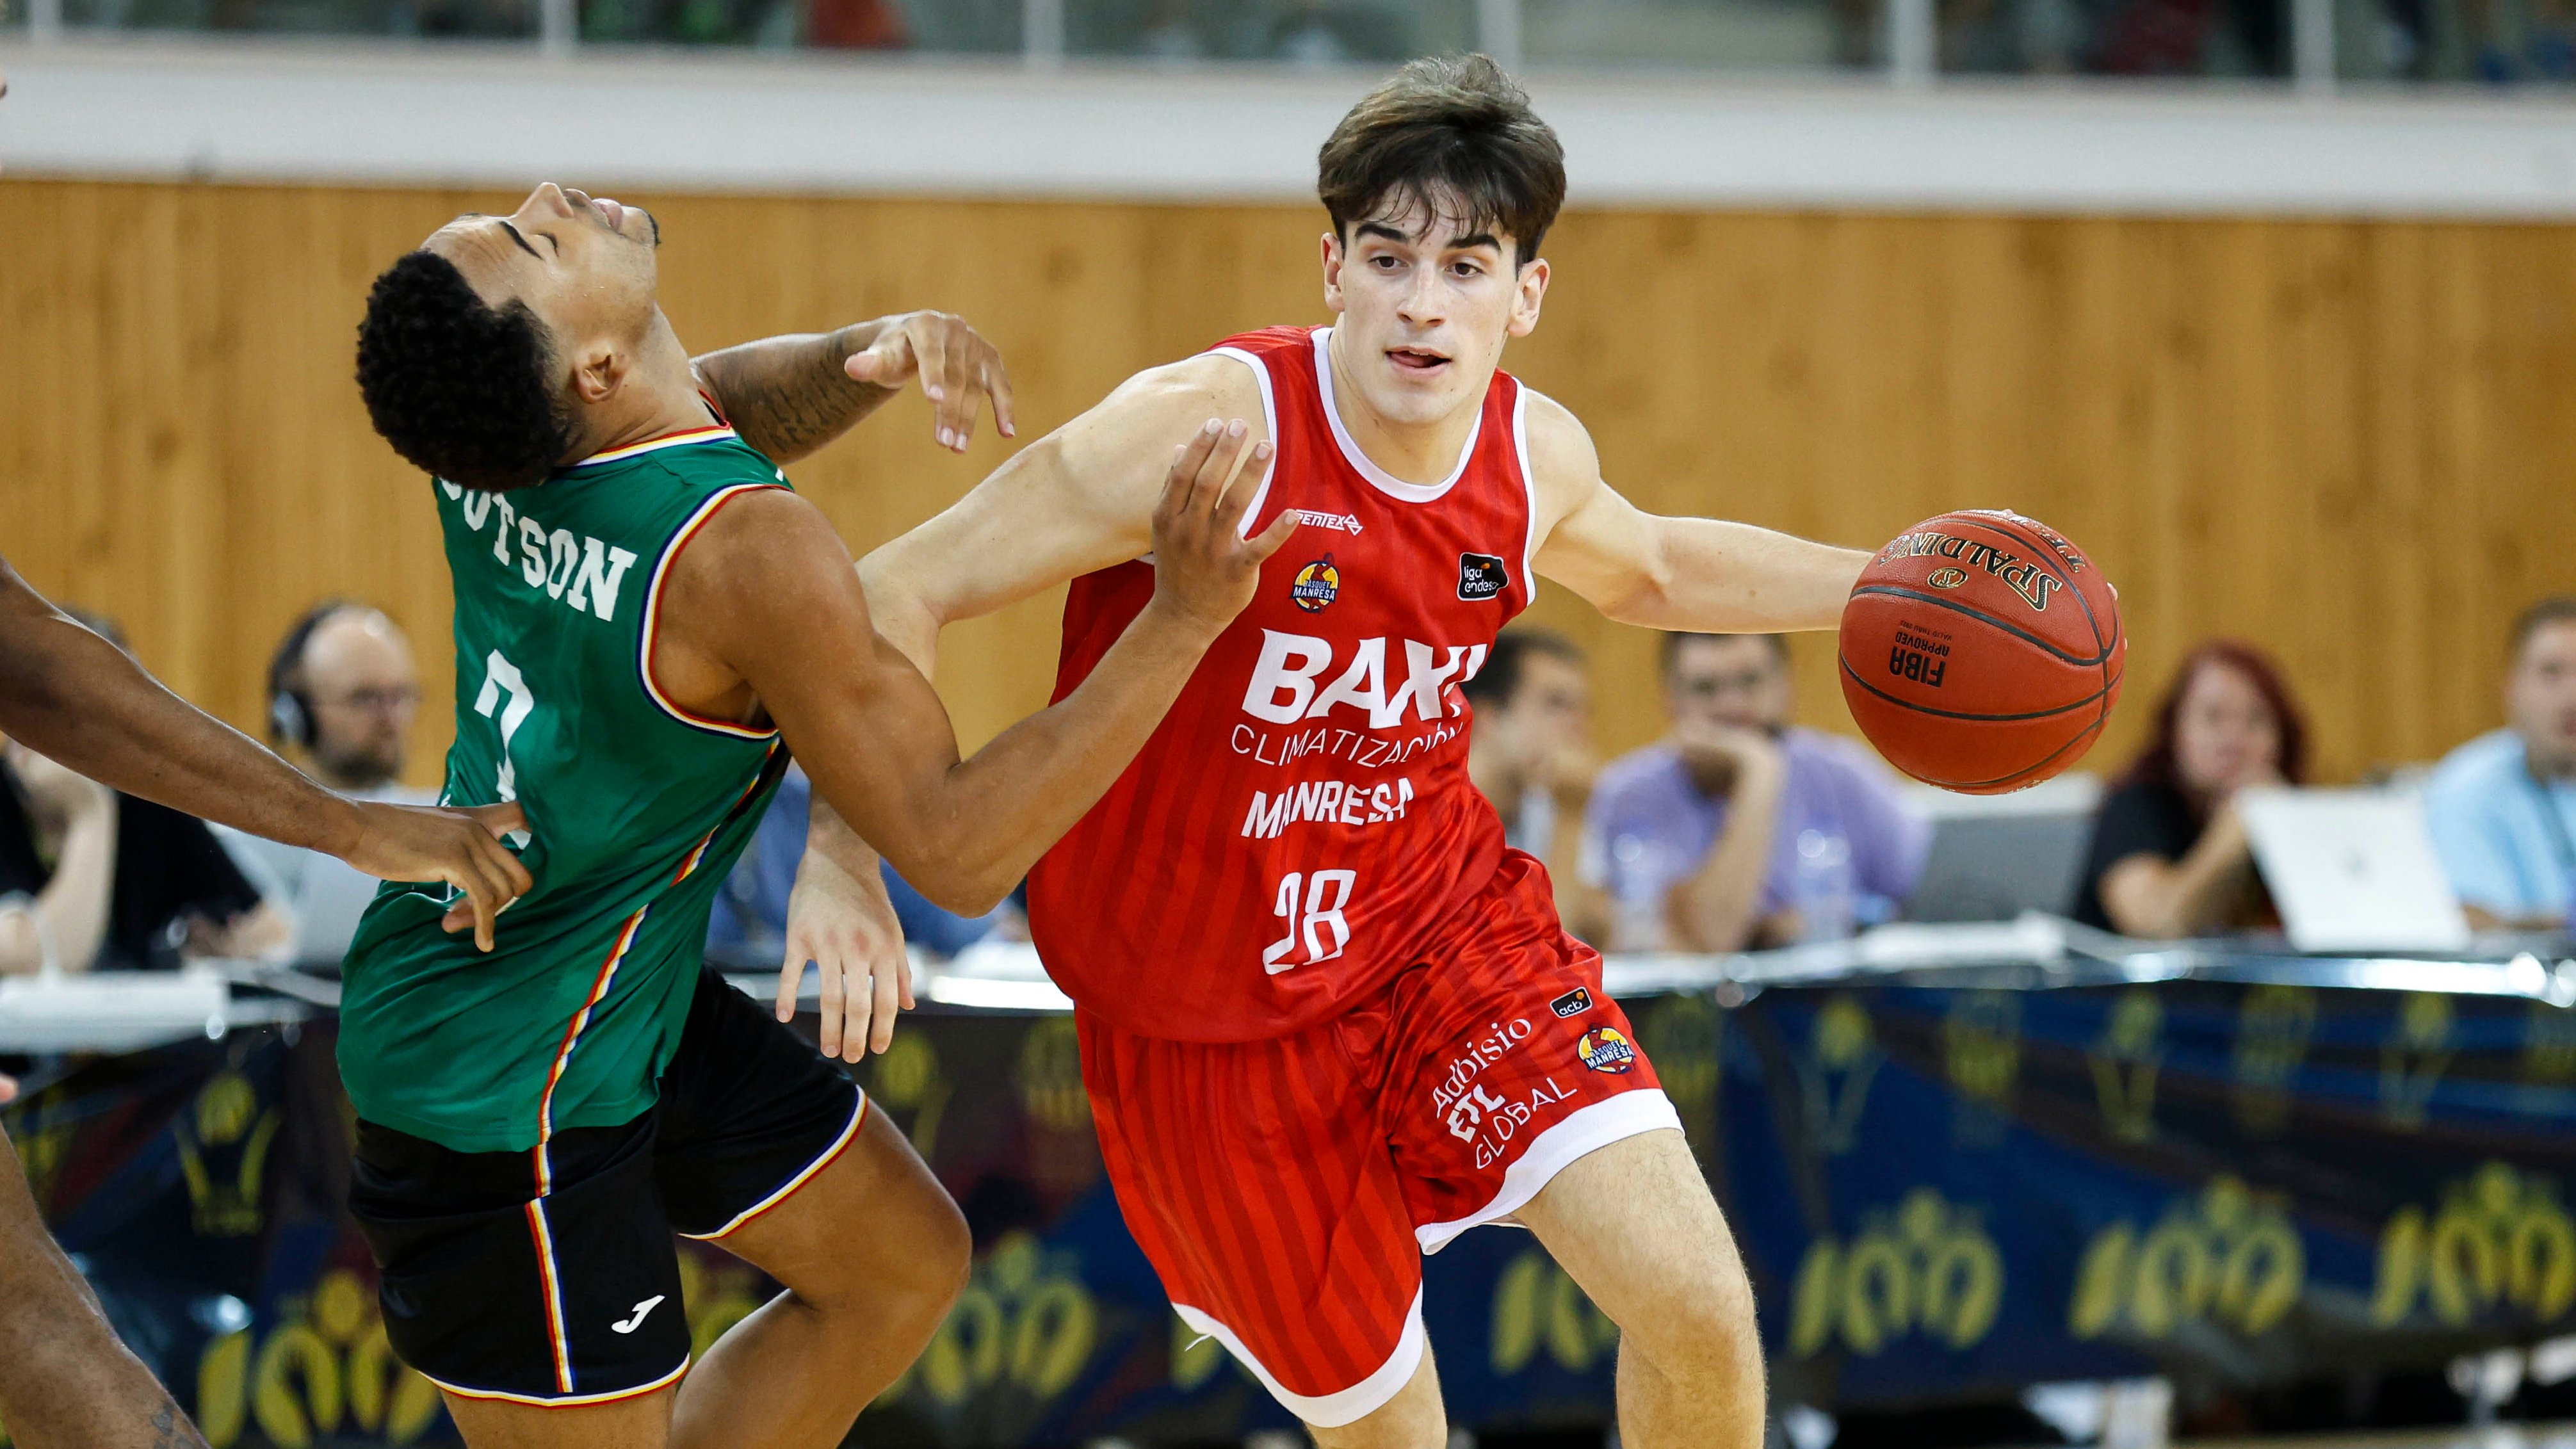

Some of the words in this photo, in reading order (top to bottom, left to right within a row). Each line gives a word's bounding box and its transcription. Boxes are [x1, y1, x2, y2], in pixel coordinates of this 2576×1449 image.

[1302, 579, 1331, 589] BASQUET
[1464, 565, 1483, 581] liga
[1879, 532, 2062, 612] SPALDING
[1293, 586, 1335, 601] MANRESA
[1895, 631, 1950, 657] APPROVED
[1889, 645, 1947, 688] FIBA
[1241, 777, 1414, 839] MANRESA
[1263, 869, 1357, 975] 28
[1559, 1001, 1583, 1016] acb
[1585, 1046, 1635, 1069] MANRESA
[1446, 1083, 1506, 1144] ETL
[1475, 1077, 1578, 1170] GLOBAL
